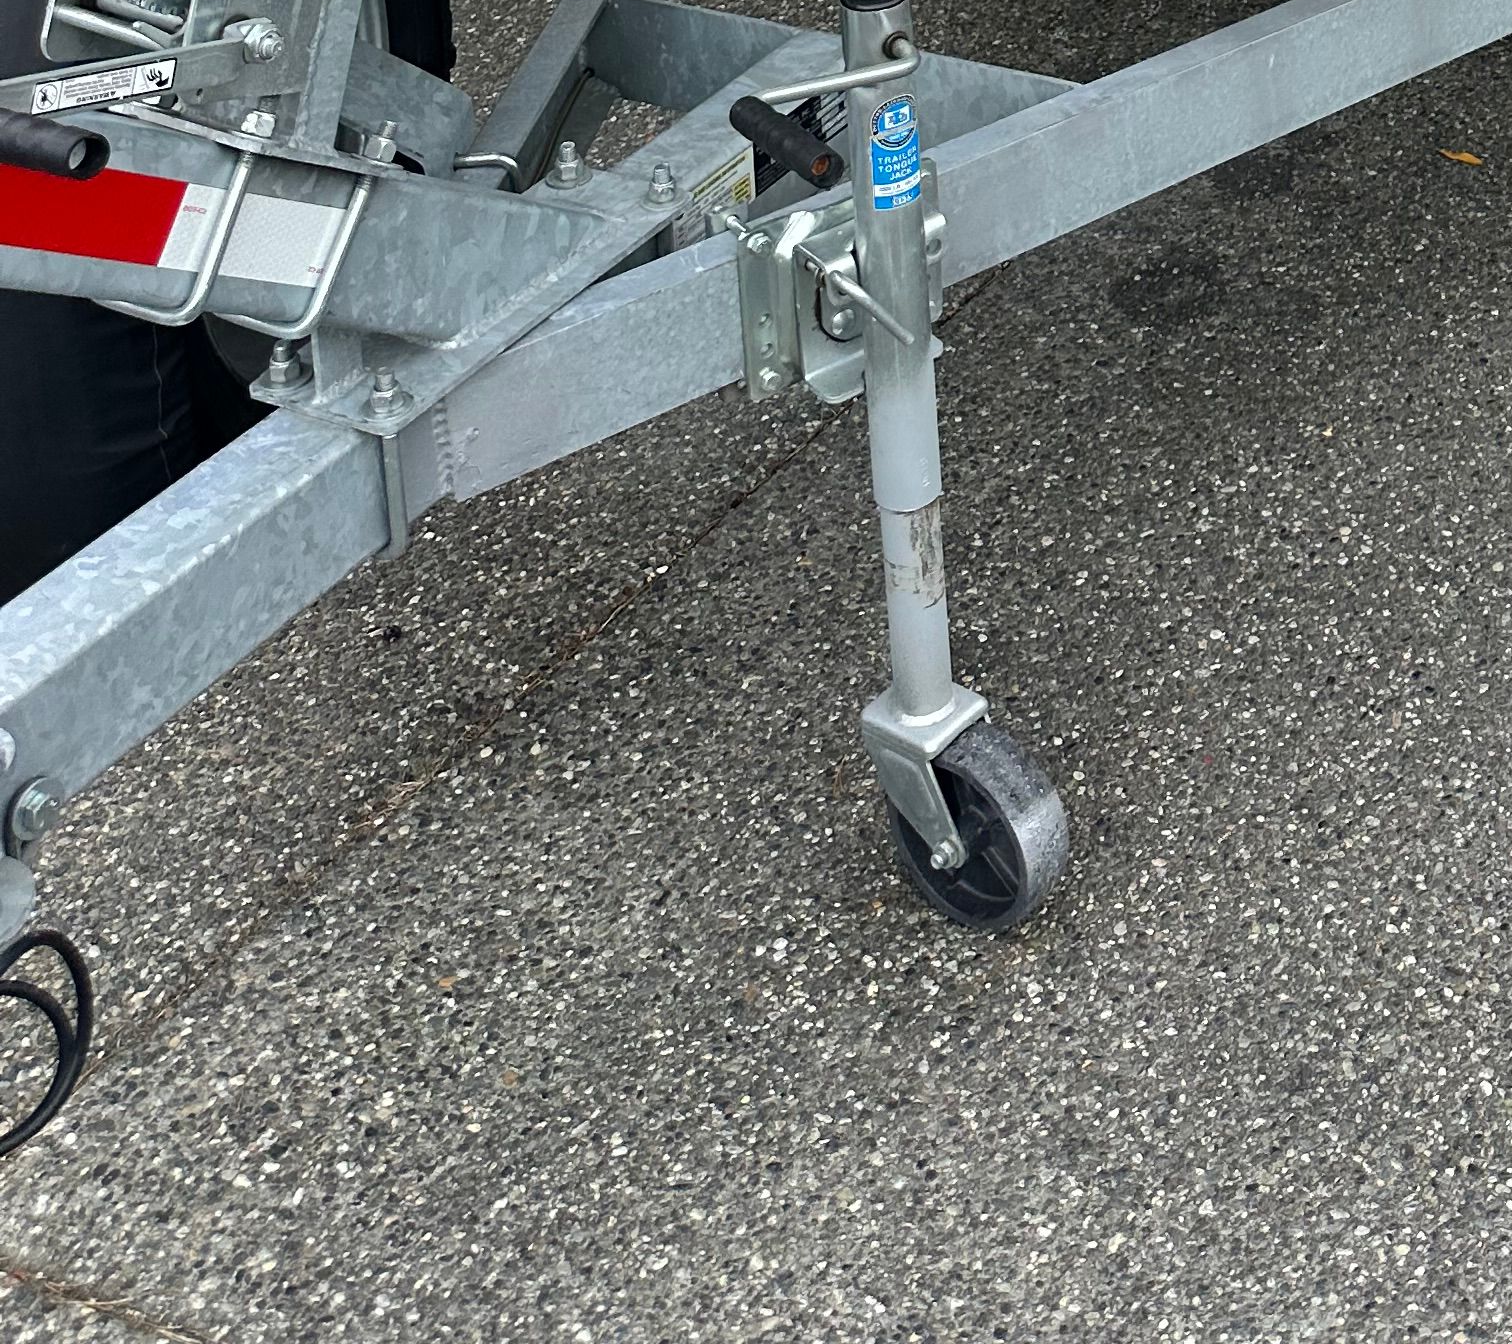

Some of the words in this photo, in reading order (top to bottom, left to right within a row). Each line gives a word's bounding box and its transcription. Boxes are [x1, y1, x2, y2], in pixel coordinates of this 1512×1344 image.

[877, 145, 917, 165] TRAILER
[878, 153, 918, 173] TONGUE
[889, 167, 913, 181] JACK
